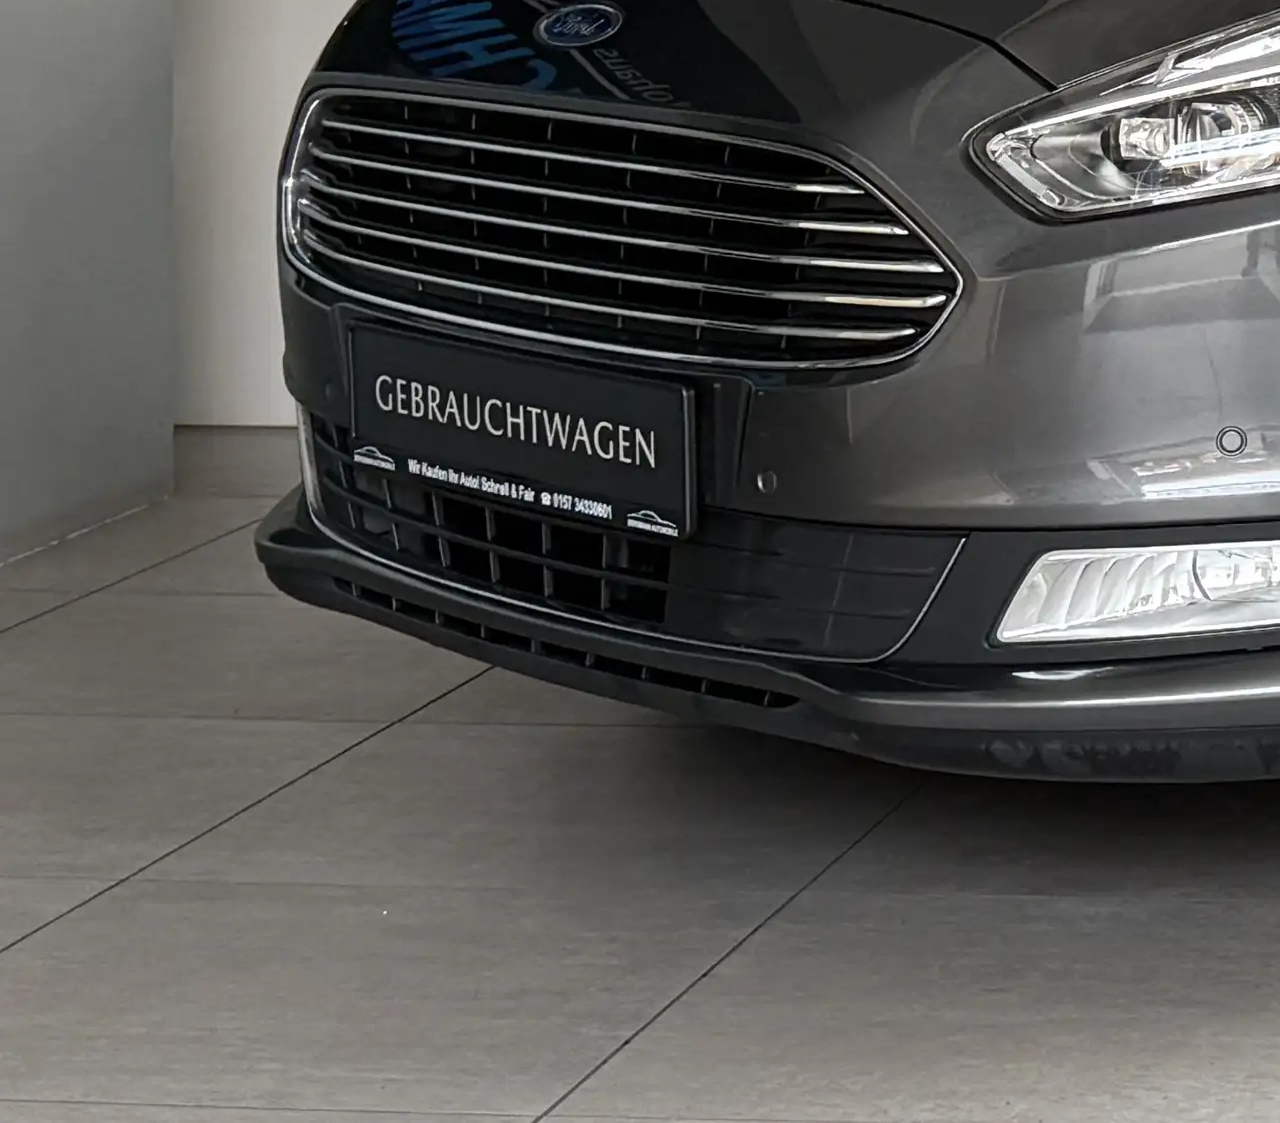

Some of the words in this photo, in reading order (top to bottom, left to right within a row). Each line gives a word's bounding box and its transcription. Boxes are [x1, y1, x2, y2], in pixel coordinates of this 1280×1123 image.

[375, 374, 656, 469] GEBRAUCHTWAGEN
[408, 458, 421, 475] Wir
[421, 461, 448, 482] Kaufen
[448, 468, 459, 484] Ihr
[481, 476, 510, 496] Schnell
[511, 483, 517, 498] &
[518, 484, 535, 502] Fair
[552, 492, 573, 510] 0157
